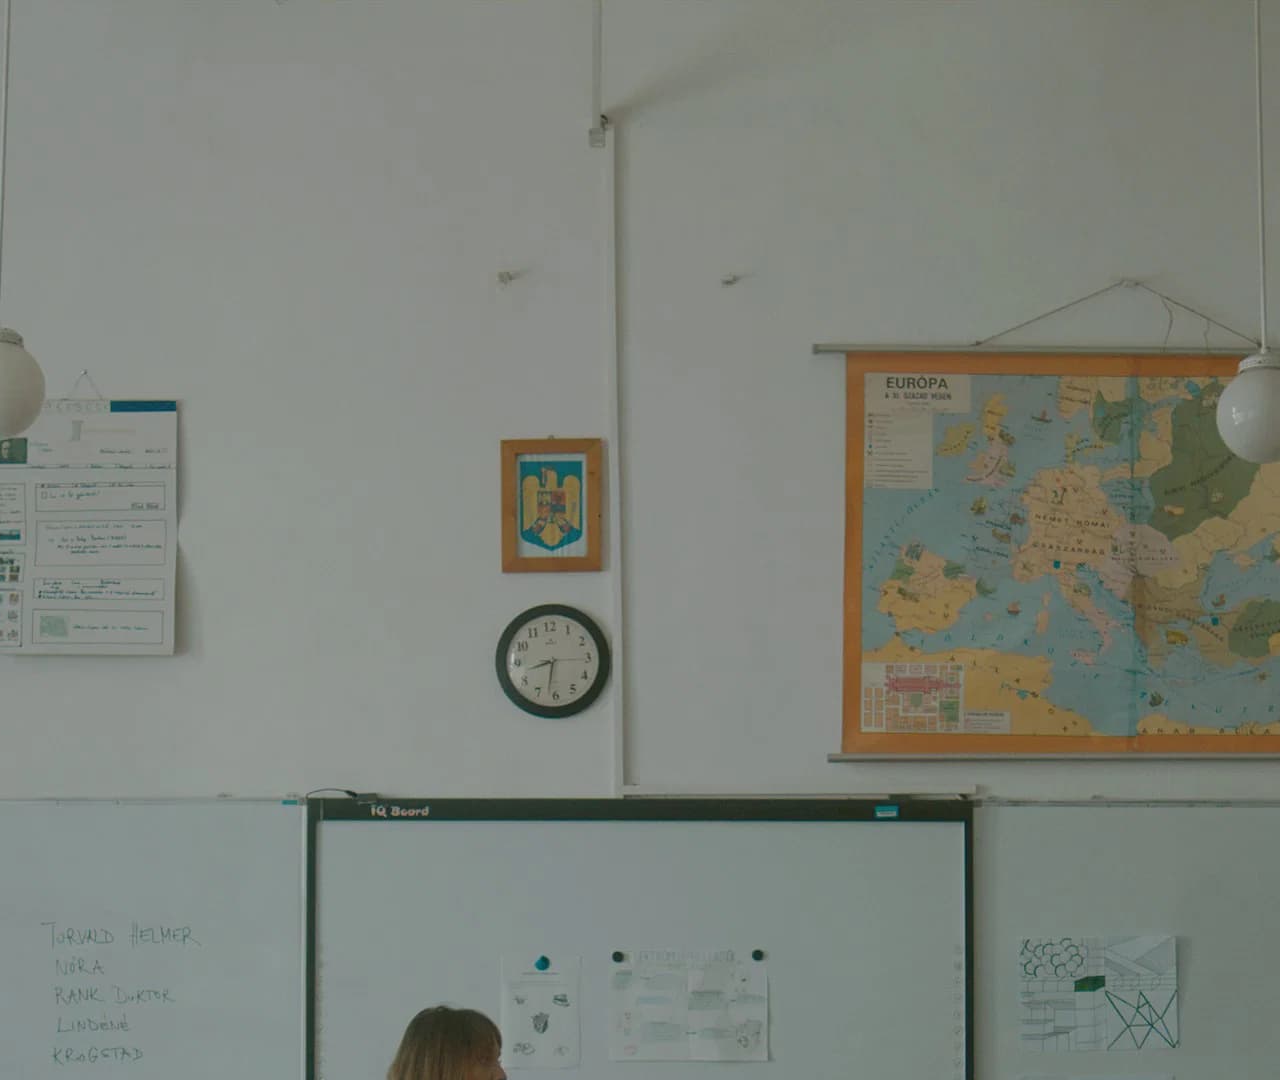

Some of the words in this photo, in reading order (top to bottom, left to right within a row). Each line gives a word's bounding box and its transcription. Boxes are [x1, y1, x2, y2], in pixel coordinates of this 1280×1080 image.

[886, 375, 949, 390] EURÓPA
[527, 627, 538, 638] 11
[543, 621, 556, 632] 12
[565, 624, 571, 636] 1
[517, 640, 529, 652] 10
[578, 636, 586, 647] 2
[584, 652, 592, 664] 3
[580, 669, 588, 681] 4
[534, 687, 541, 697] 7
[569, 683, 577, 695] 5
[552, 690, 560, 701] 6
